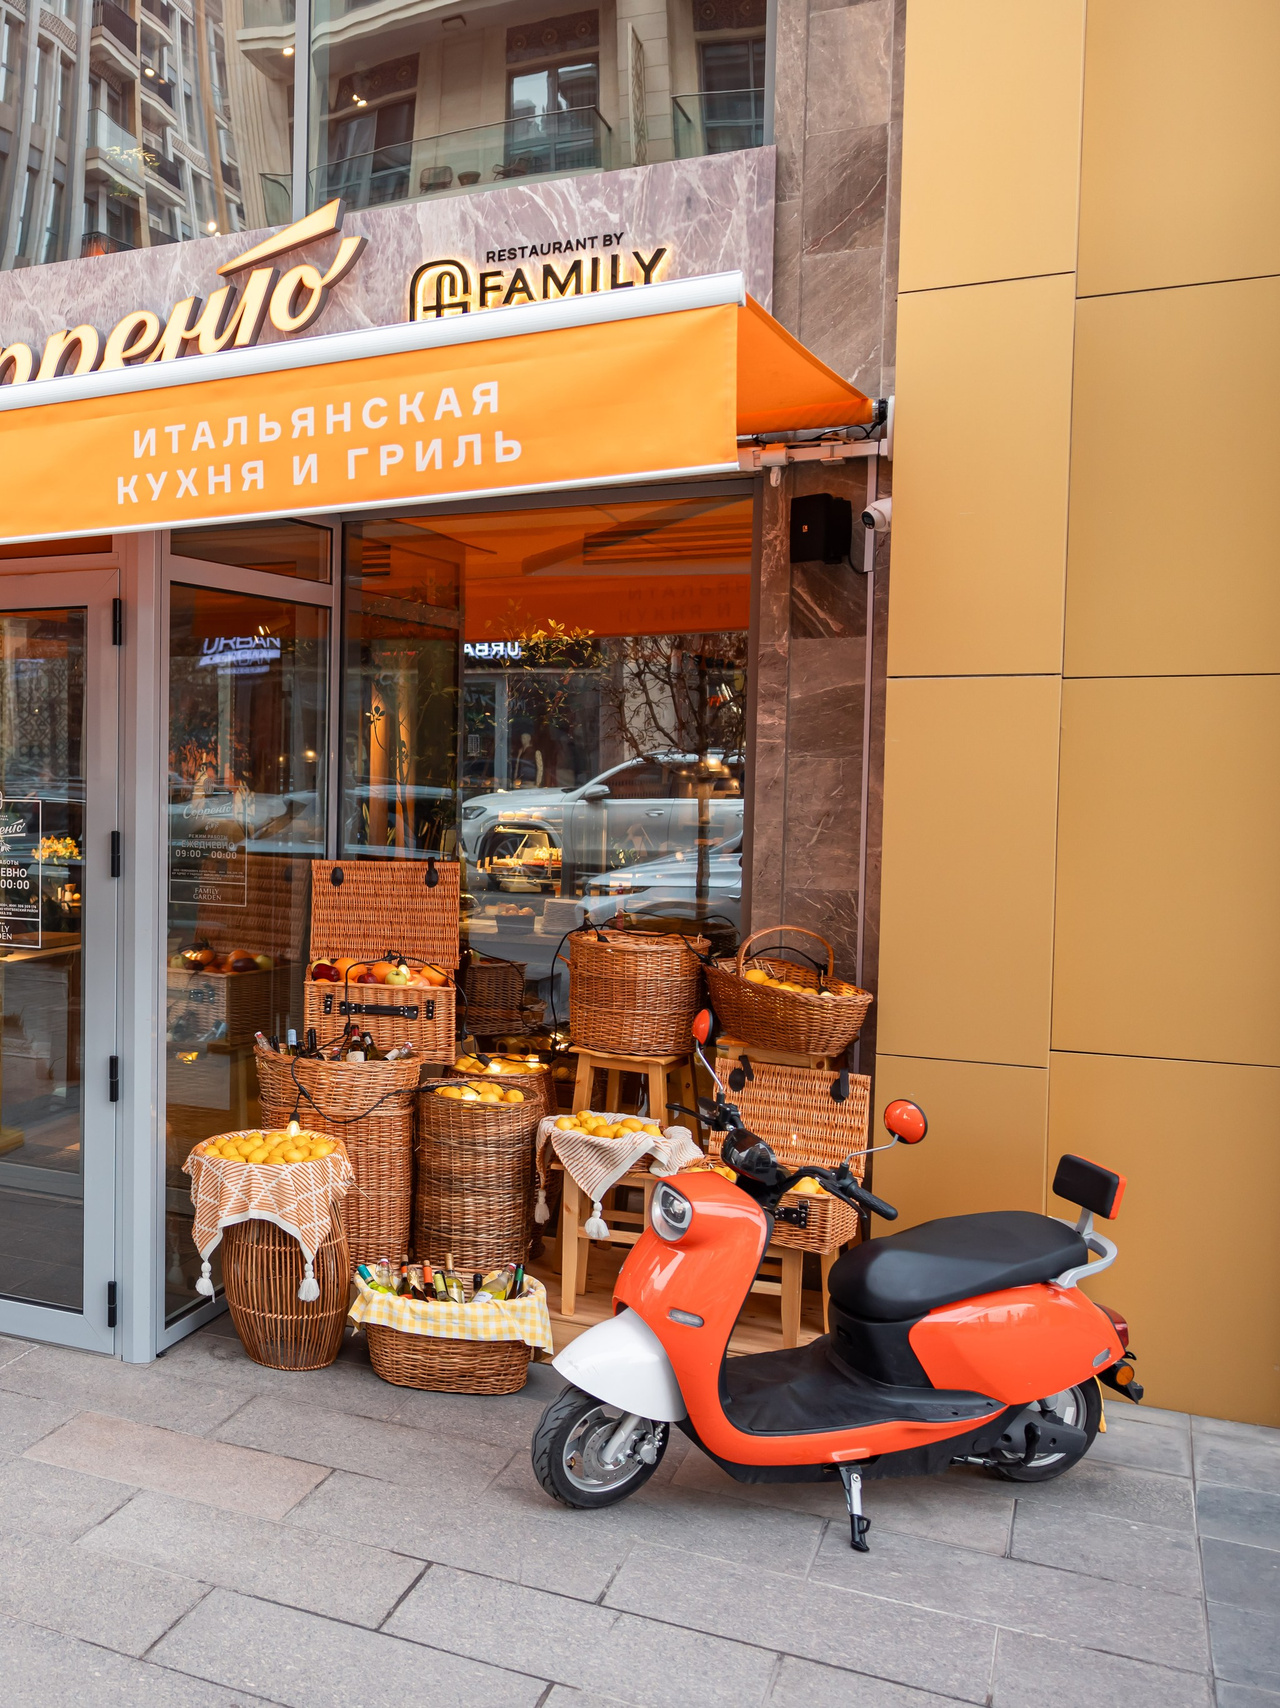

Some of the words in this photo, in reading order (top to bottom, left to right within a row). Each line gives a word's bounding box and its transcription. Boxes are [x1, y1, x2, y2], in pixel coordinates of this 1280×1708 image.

[486, 236, 598, 263] RESTAURANT
[603, 232, 625, 248] BY
[479, 247, 667, 308] FAMILY
[133, 381, 499, 459] ИТАЛЬЯНСКАЯ
[117, 460, 265, 505] КУХНЯ
[293, 453, 318, 486] И
[347, 431, 522, 480] ГРИЛЬ
[180, 839, 235, 850] ЕЖЕДНЕВНО
[175, 849, 201, 858] 09:00
[210, 851, 237, 859] 00:00
[0, 879, 30, 890] 00:00
[194, 887, 220, 895] FAMILY
[192, 893, 222, 901] GARDEN
